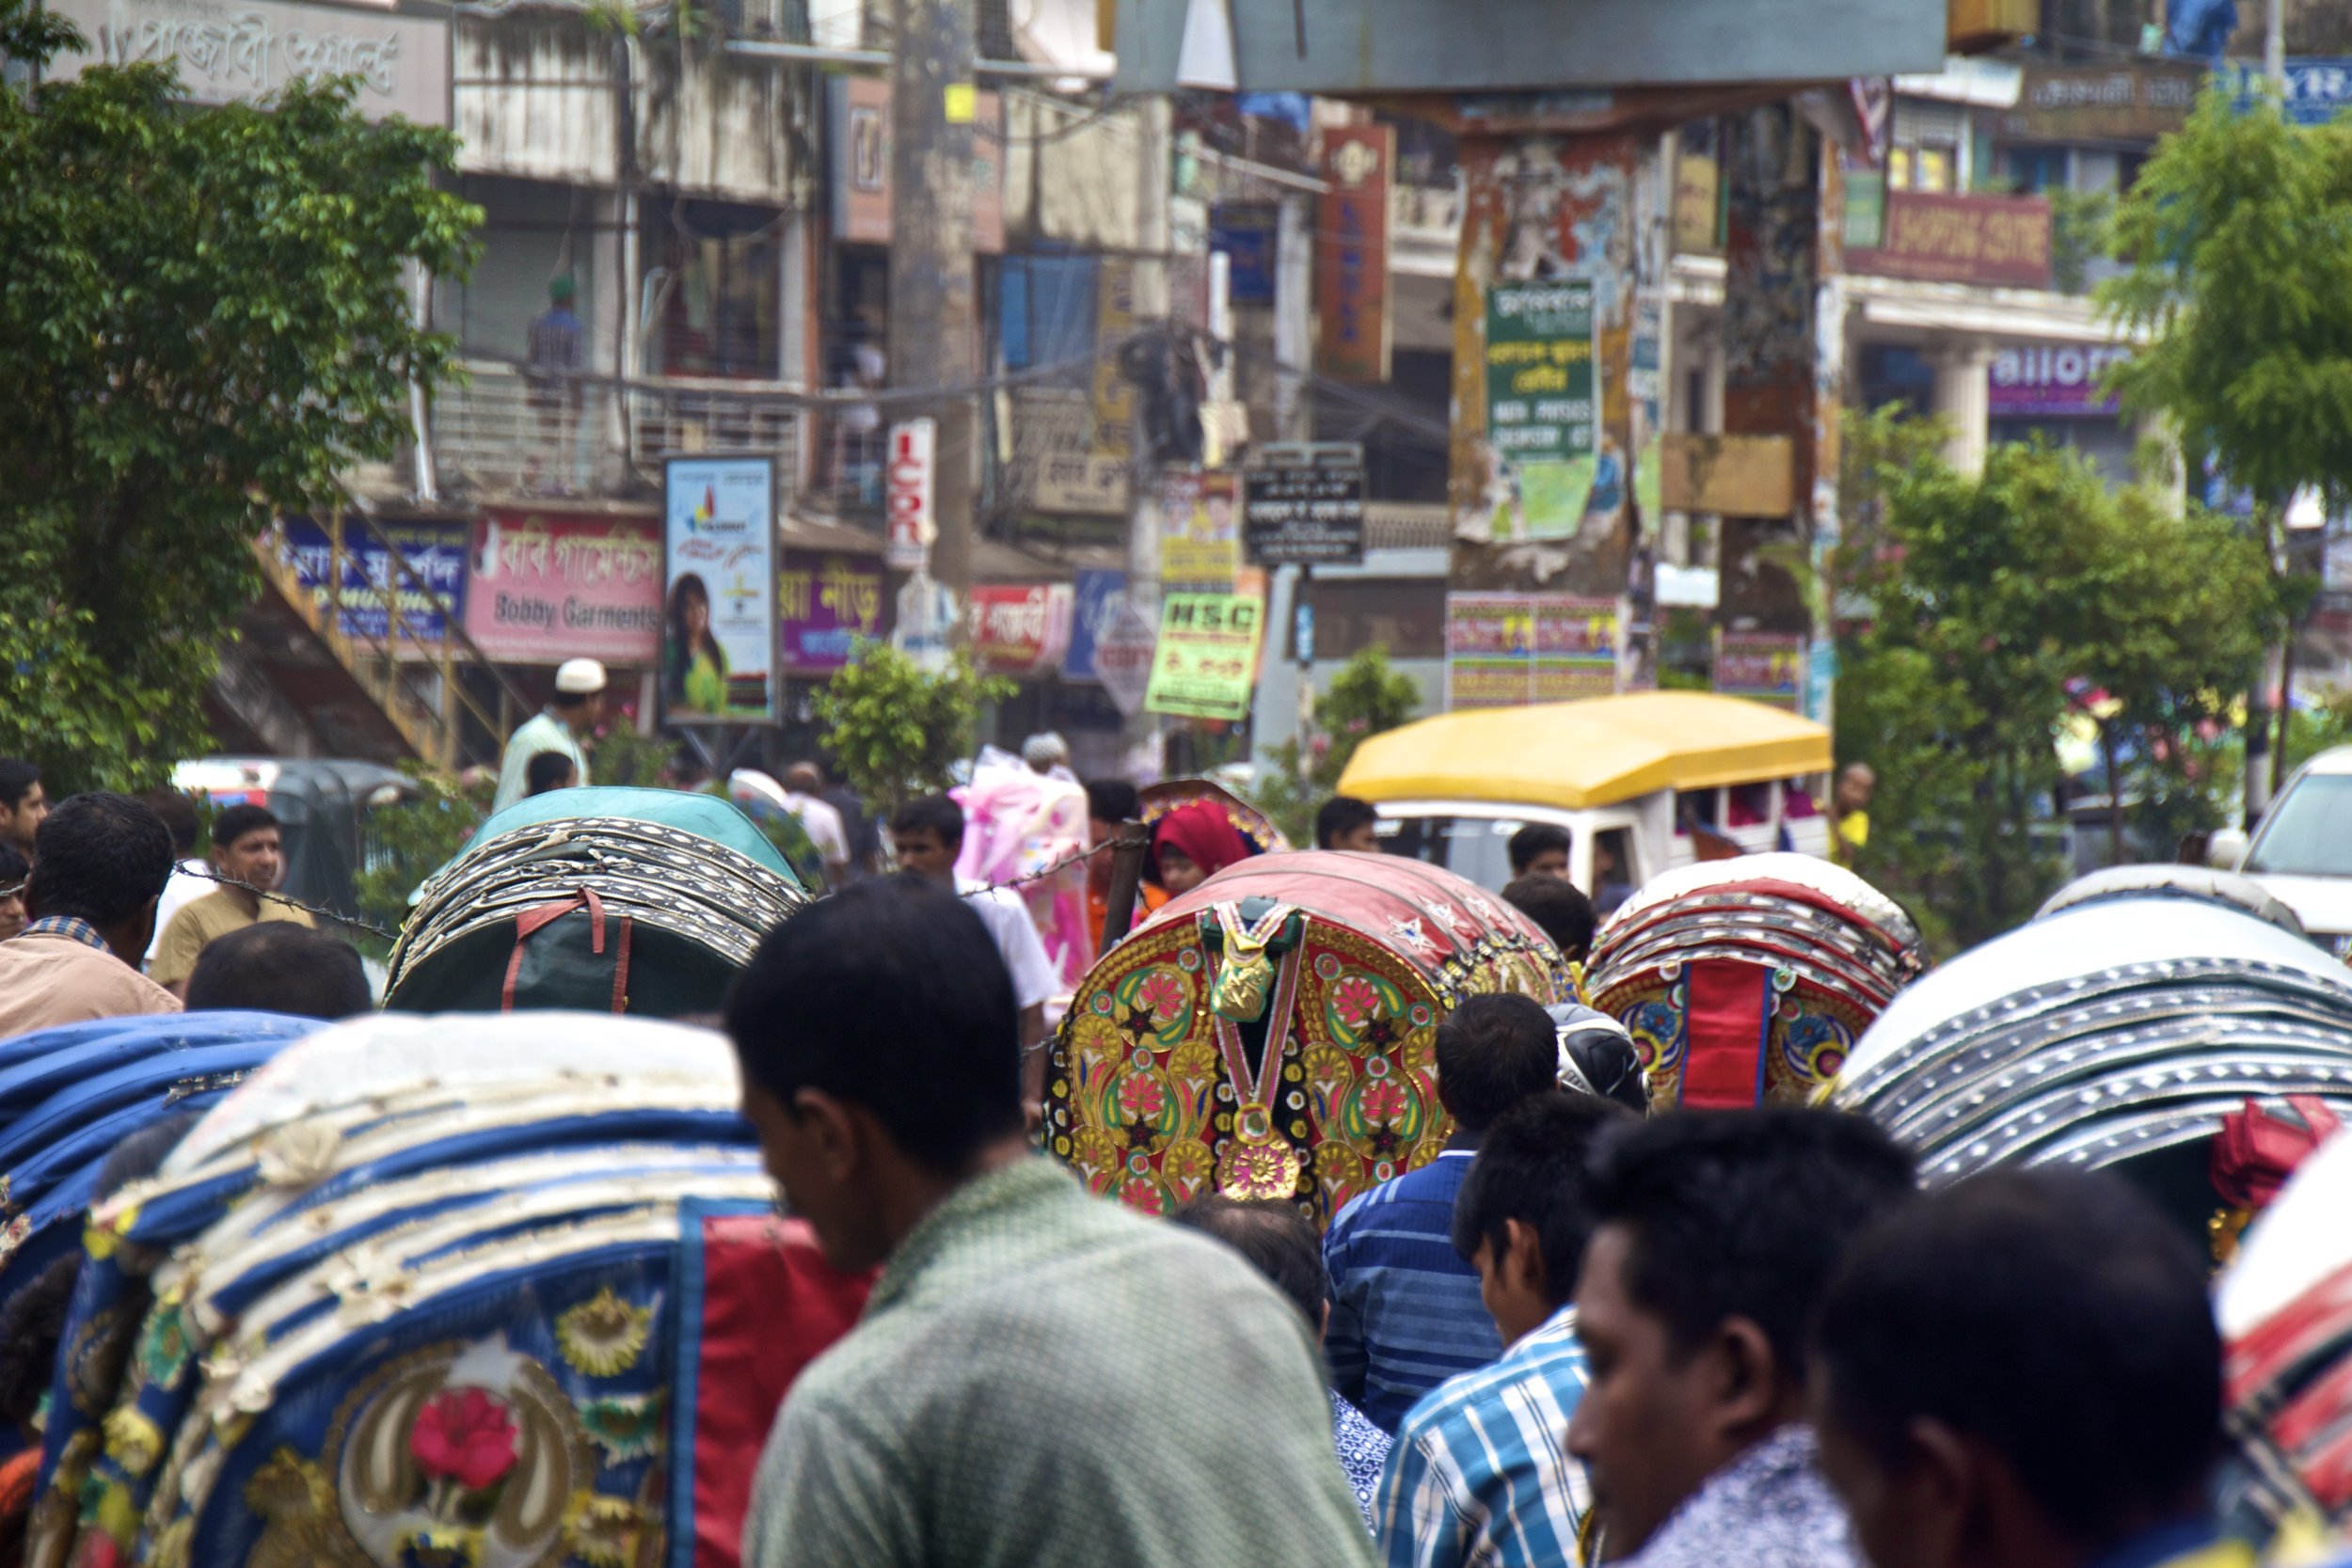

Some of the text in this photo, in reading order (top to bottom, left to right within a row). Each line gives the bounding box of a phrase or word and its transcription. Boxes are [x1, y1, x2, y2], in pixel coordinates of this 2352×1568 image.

[495, 592, 660, 635] Bobby Garments
[1168, 602, 1255, 632] HSC
